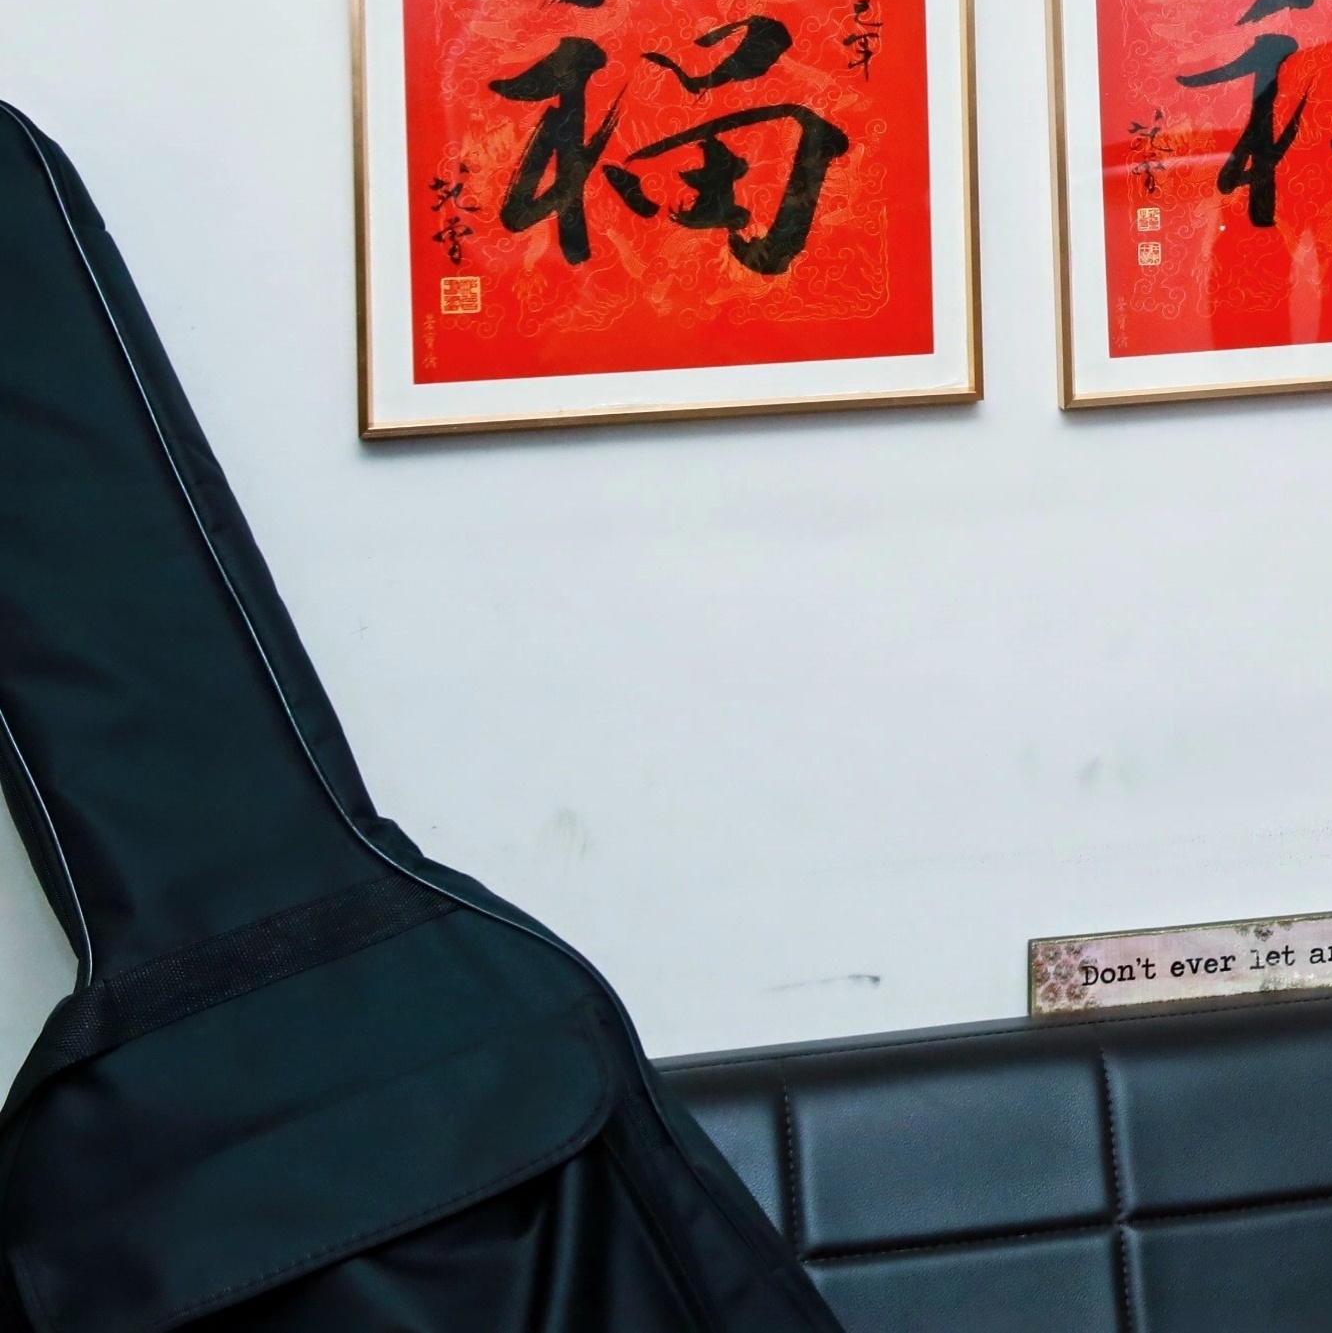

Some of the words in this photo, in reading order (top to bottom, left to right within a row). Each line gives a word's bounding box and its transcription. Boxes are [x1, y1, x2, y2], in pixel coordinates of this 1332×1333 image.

[1081, 958, 1156, 986] Don't
[1170, 953, 1236, 977] ever
[1250, 945, 1295, 969] let
